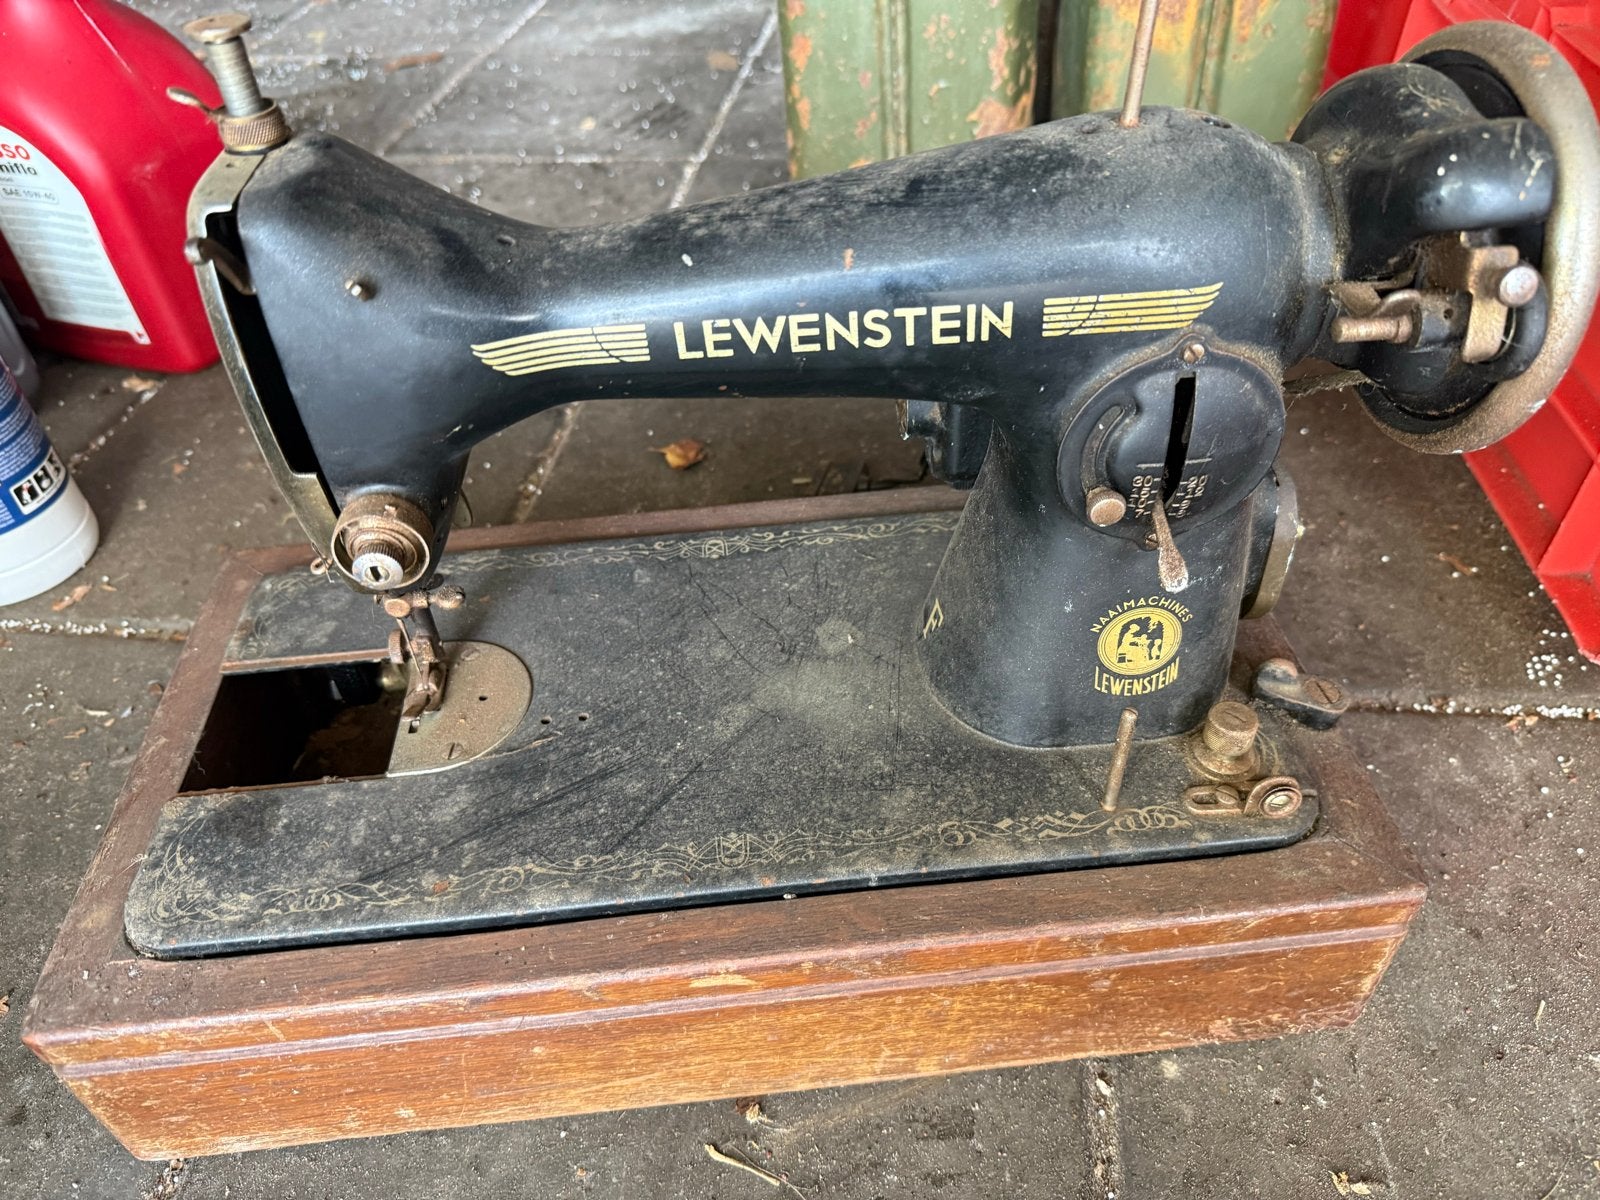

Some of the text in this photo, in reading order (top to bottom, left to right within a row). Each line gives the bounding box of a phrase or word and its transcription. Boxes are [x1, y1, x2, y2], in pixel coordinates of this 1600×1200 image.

[0, 143, 31, 161] SO
[673, 301, 1014, 360] LEWENSTEIN
[1132, 475, 1153, 487] 30
[1187, 474, 1208, 489] 20
[1184, 486, 1205, 499] 12
[1090, 595, 1193, 633] NAAIMACHINES
[1094, 656, 1180, 697] LEWENSTEIN
